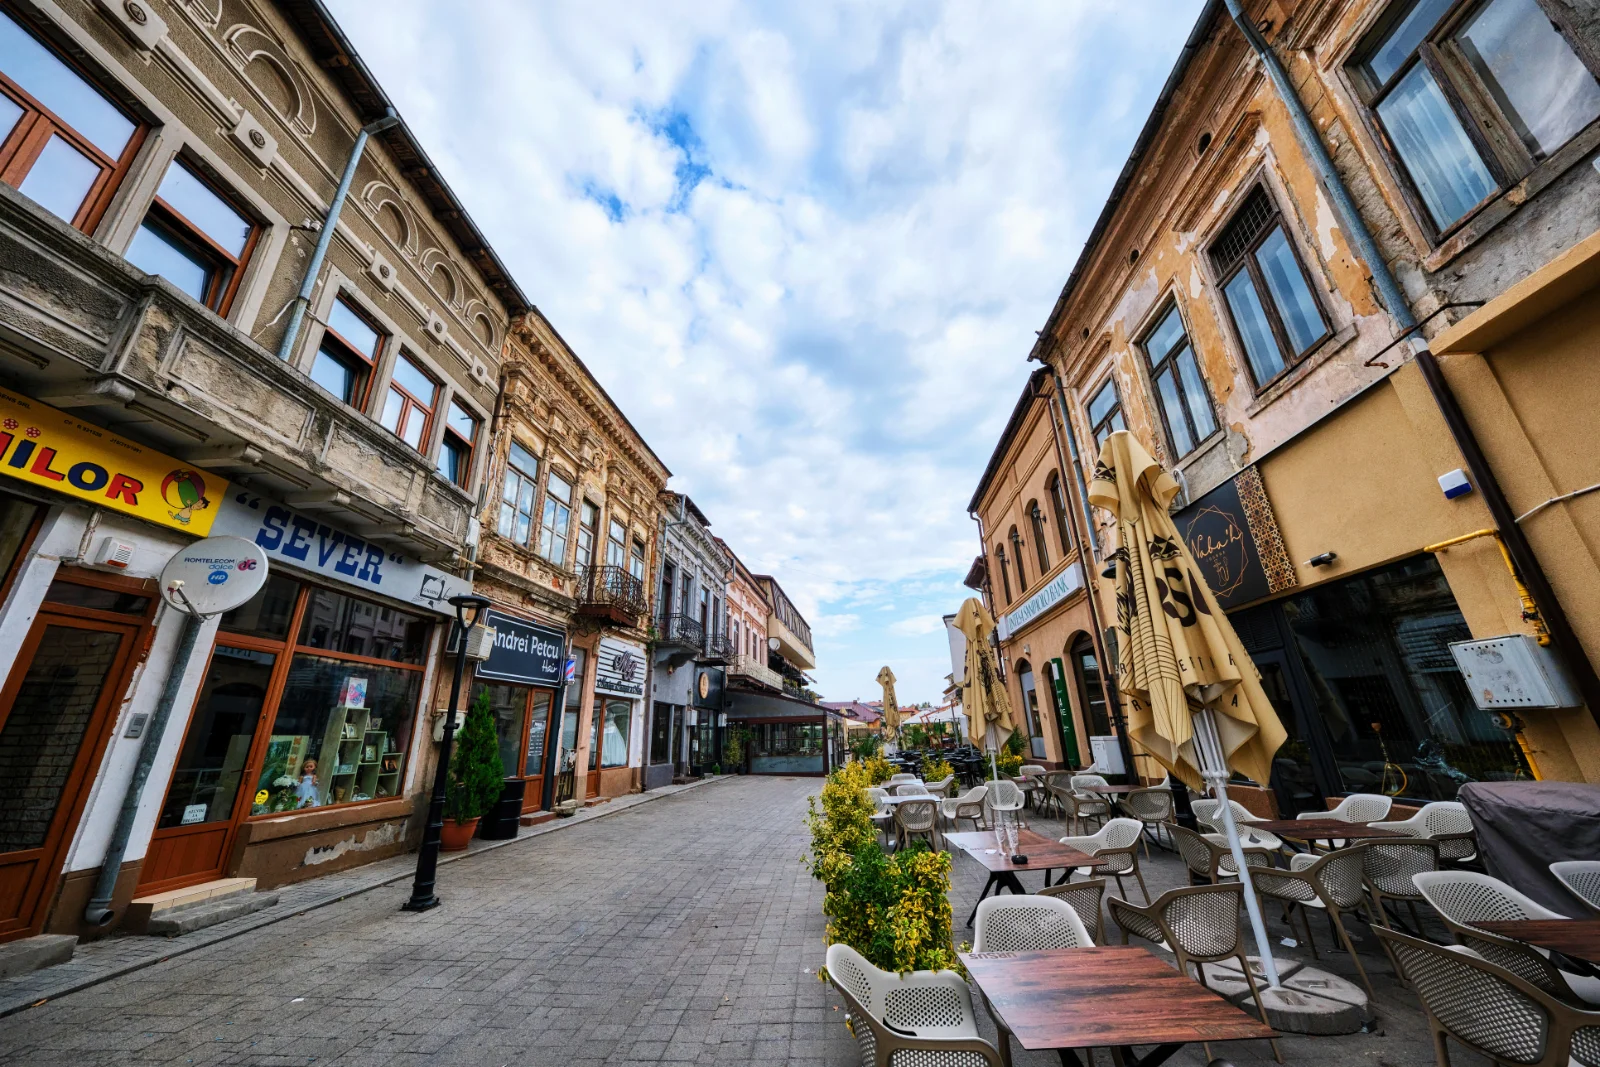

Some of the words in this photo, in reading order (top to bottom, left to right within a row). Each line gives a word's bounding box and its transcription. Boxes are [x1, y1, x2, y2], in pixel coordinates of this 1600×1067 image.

[1050, 574, 1070, 602] BANK
[492, 625, 529, 653] Andrei
[530, 635, 559, 659] Petcu
[541, 659, 558, 674] Hair
[968, 951, 1017, 959] URSUS
